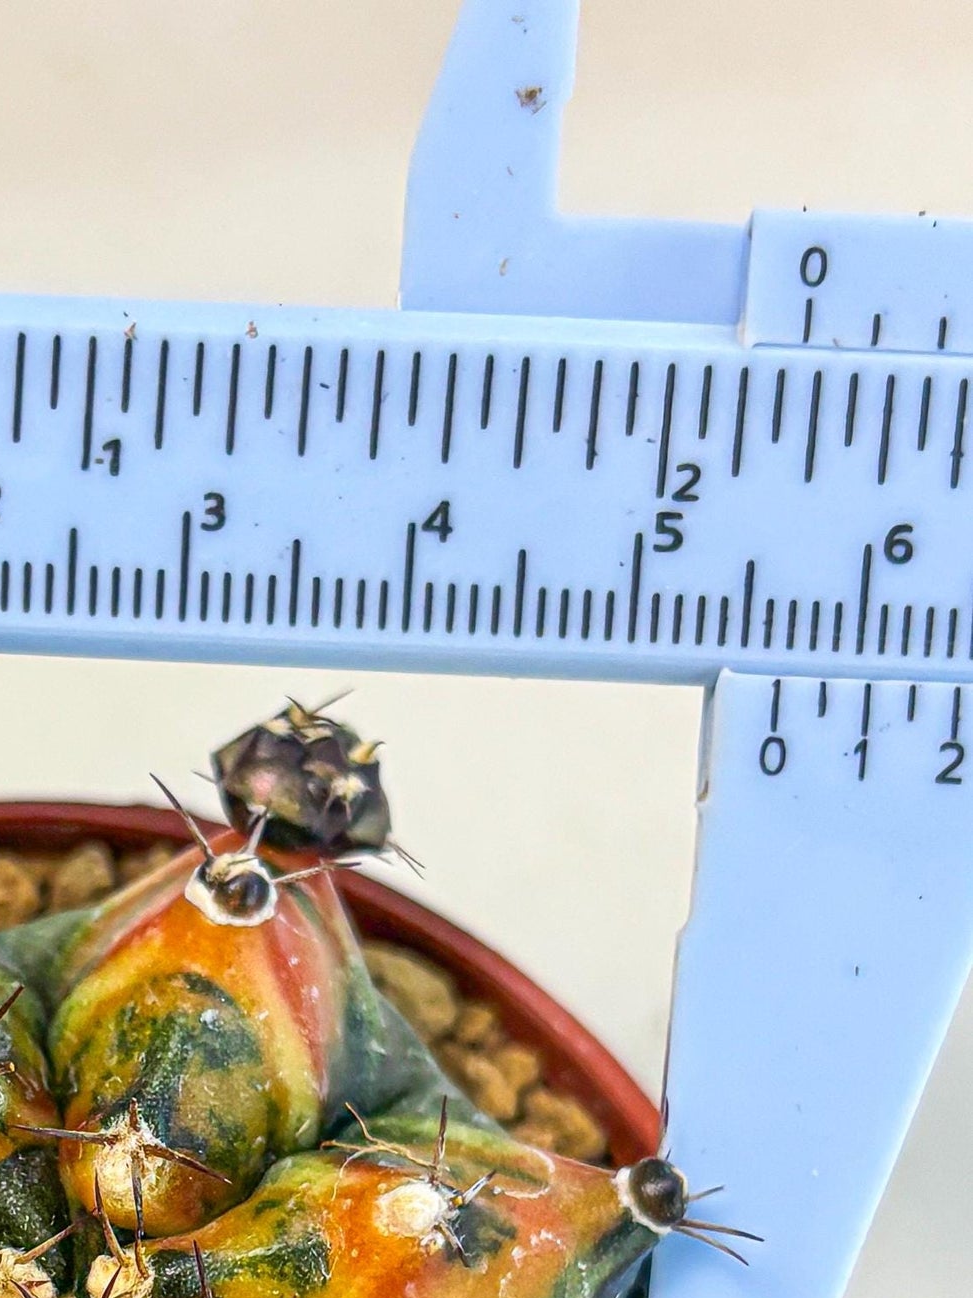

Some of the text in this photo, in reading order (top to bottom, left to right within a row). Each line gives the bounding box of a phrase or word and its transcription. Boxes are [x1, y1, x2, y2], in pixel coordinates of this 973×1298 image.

[799, 246, 828, 288] 0
[101, 438, 123, 477] 1
[671, 462, 702, 503] 2
[200, 491, 227, 532] 3
[421, 500, 454, 543] 4
[652, 511, 684, 553] 5
[883, 523, 914, 565] 6
[759, 736, 964, 785] 0 1 2
